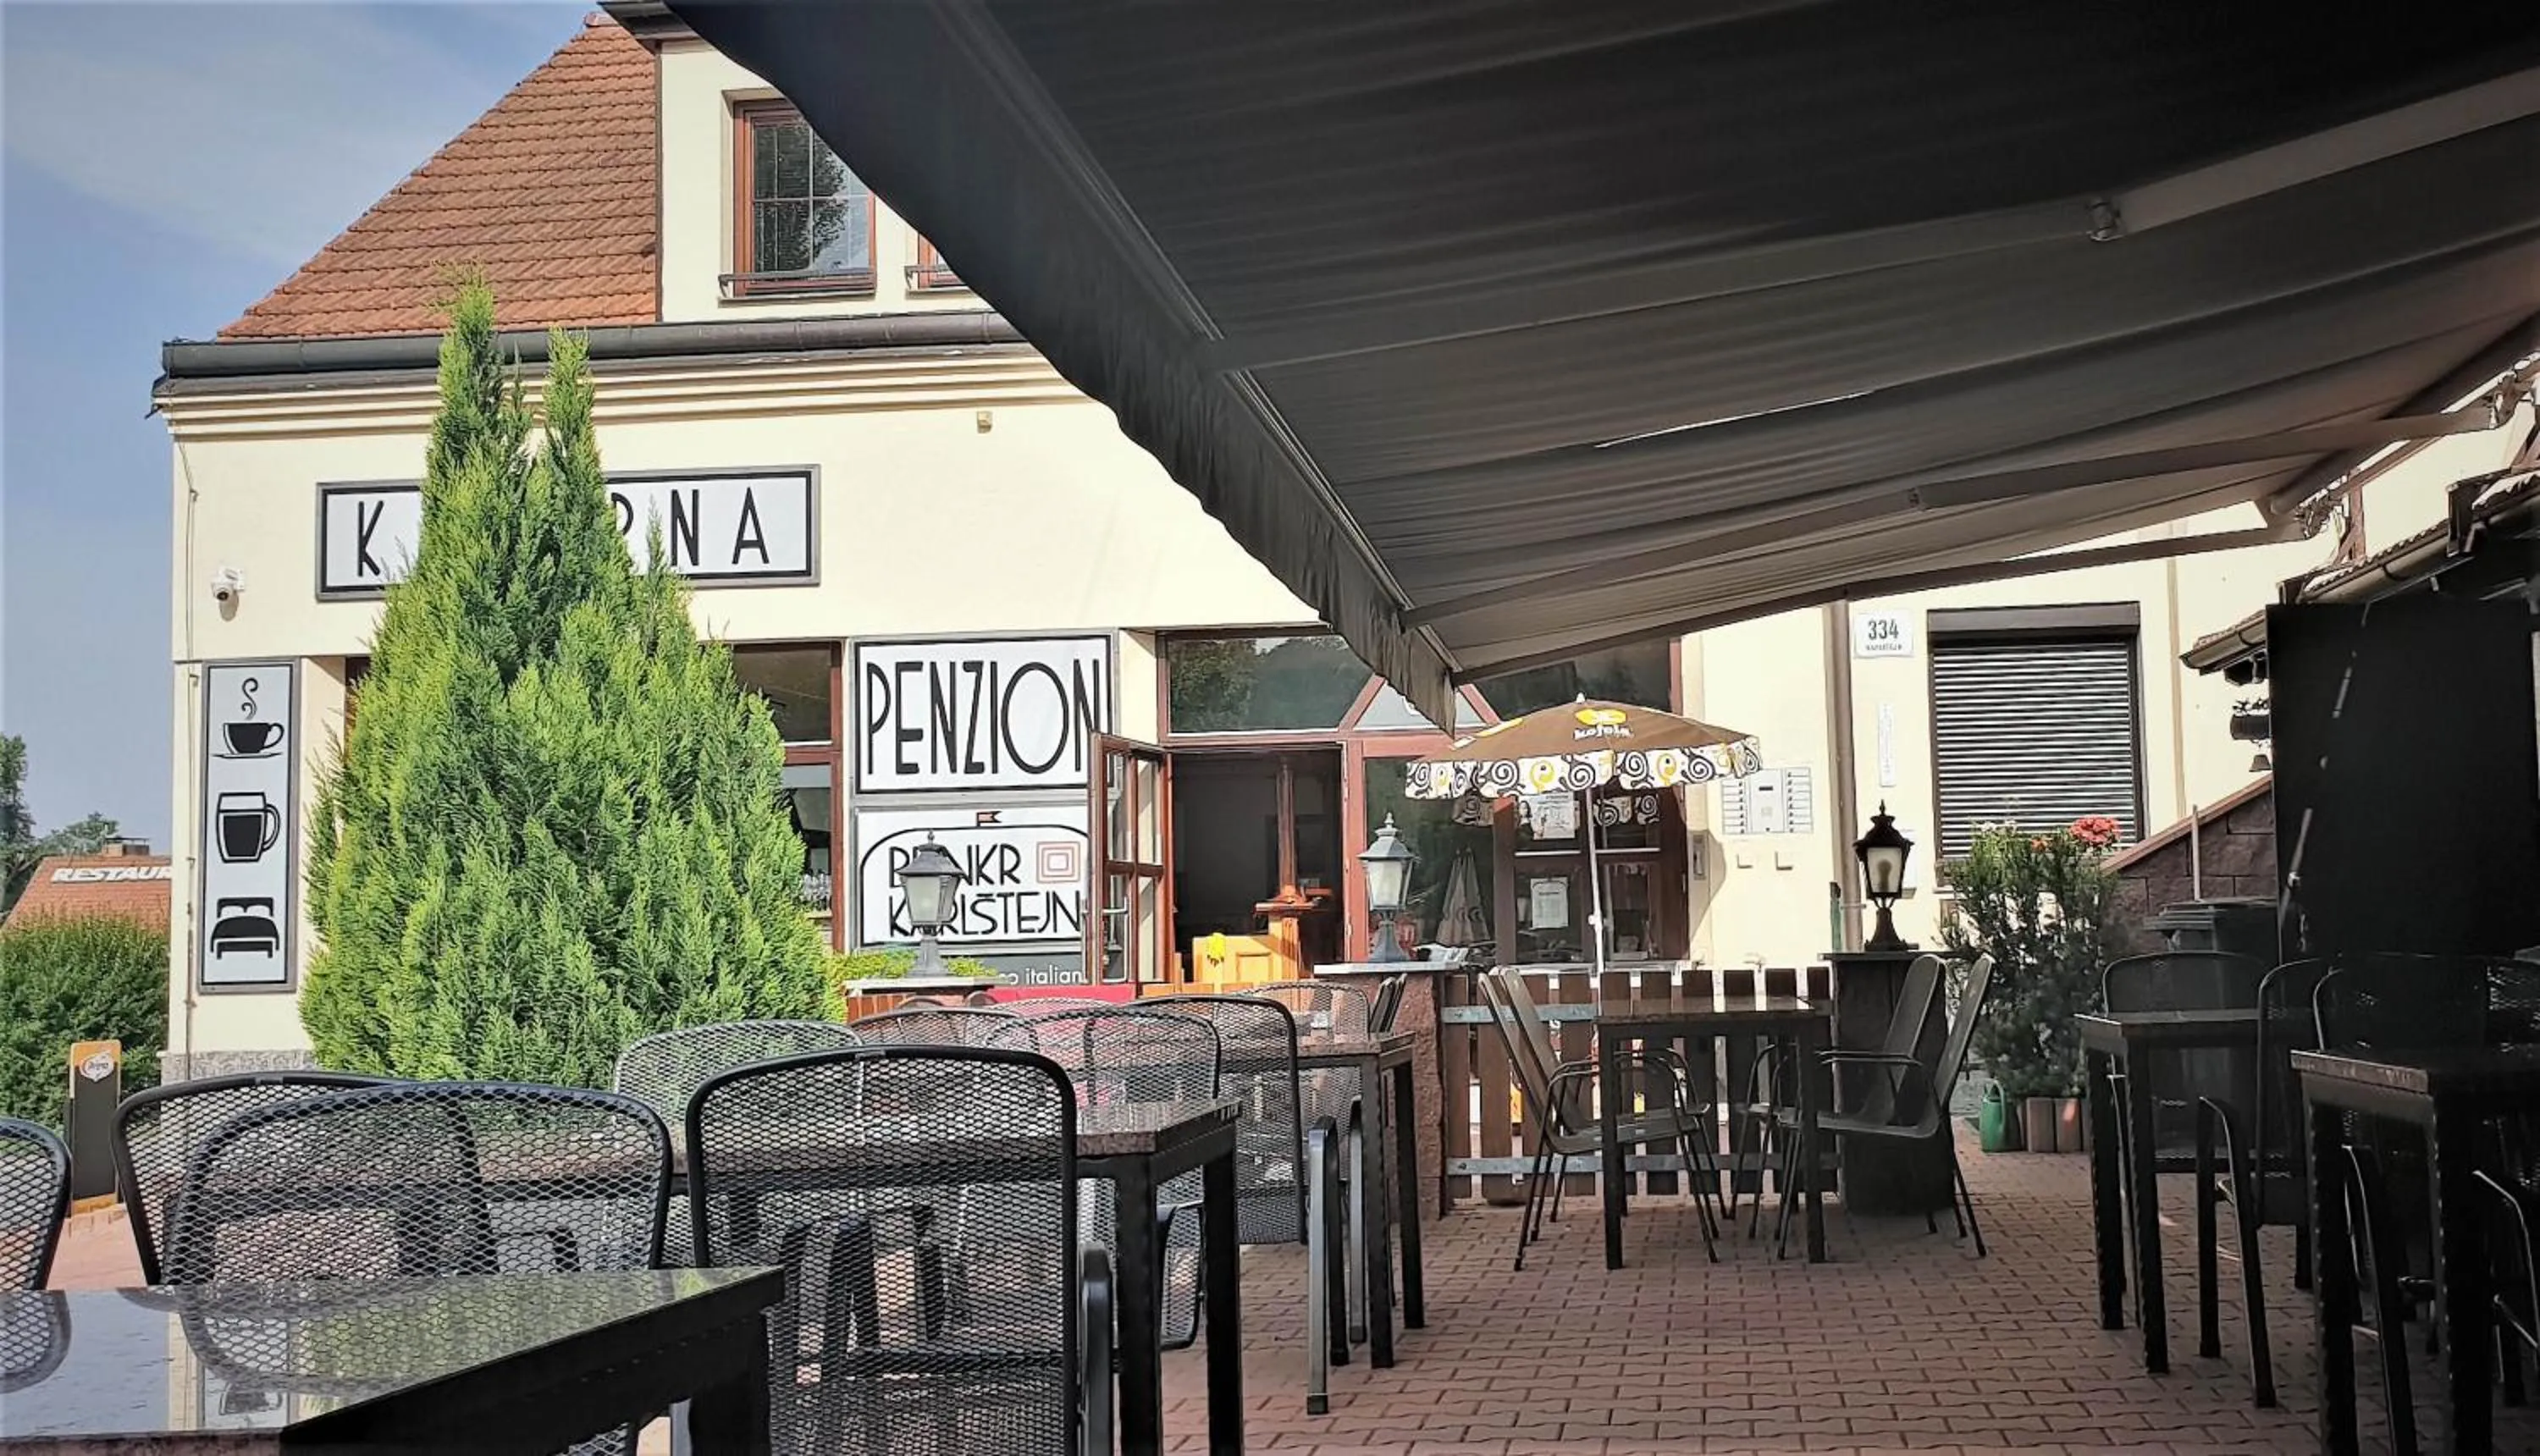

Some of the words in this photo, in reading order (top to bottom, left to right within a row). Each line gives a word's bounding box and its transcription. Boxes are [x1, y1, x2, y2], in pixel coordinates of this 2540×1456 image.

[1868, 619, 1899, 640] 334
[866, 659, 1100, 775] PENZION
[890, 843, 1021, 888] BNKR
[889, 891, 1080, 937] KRLŠTEJN
